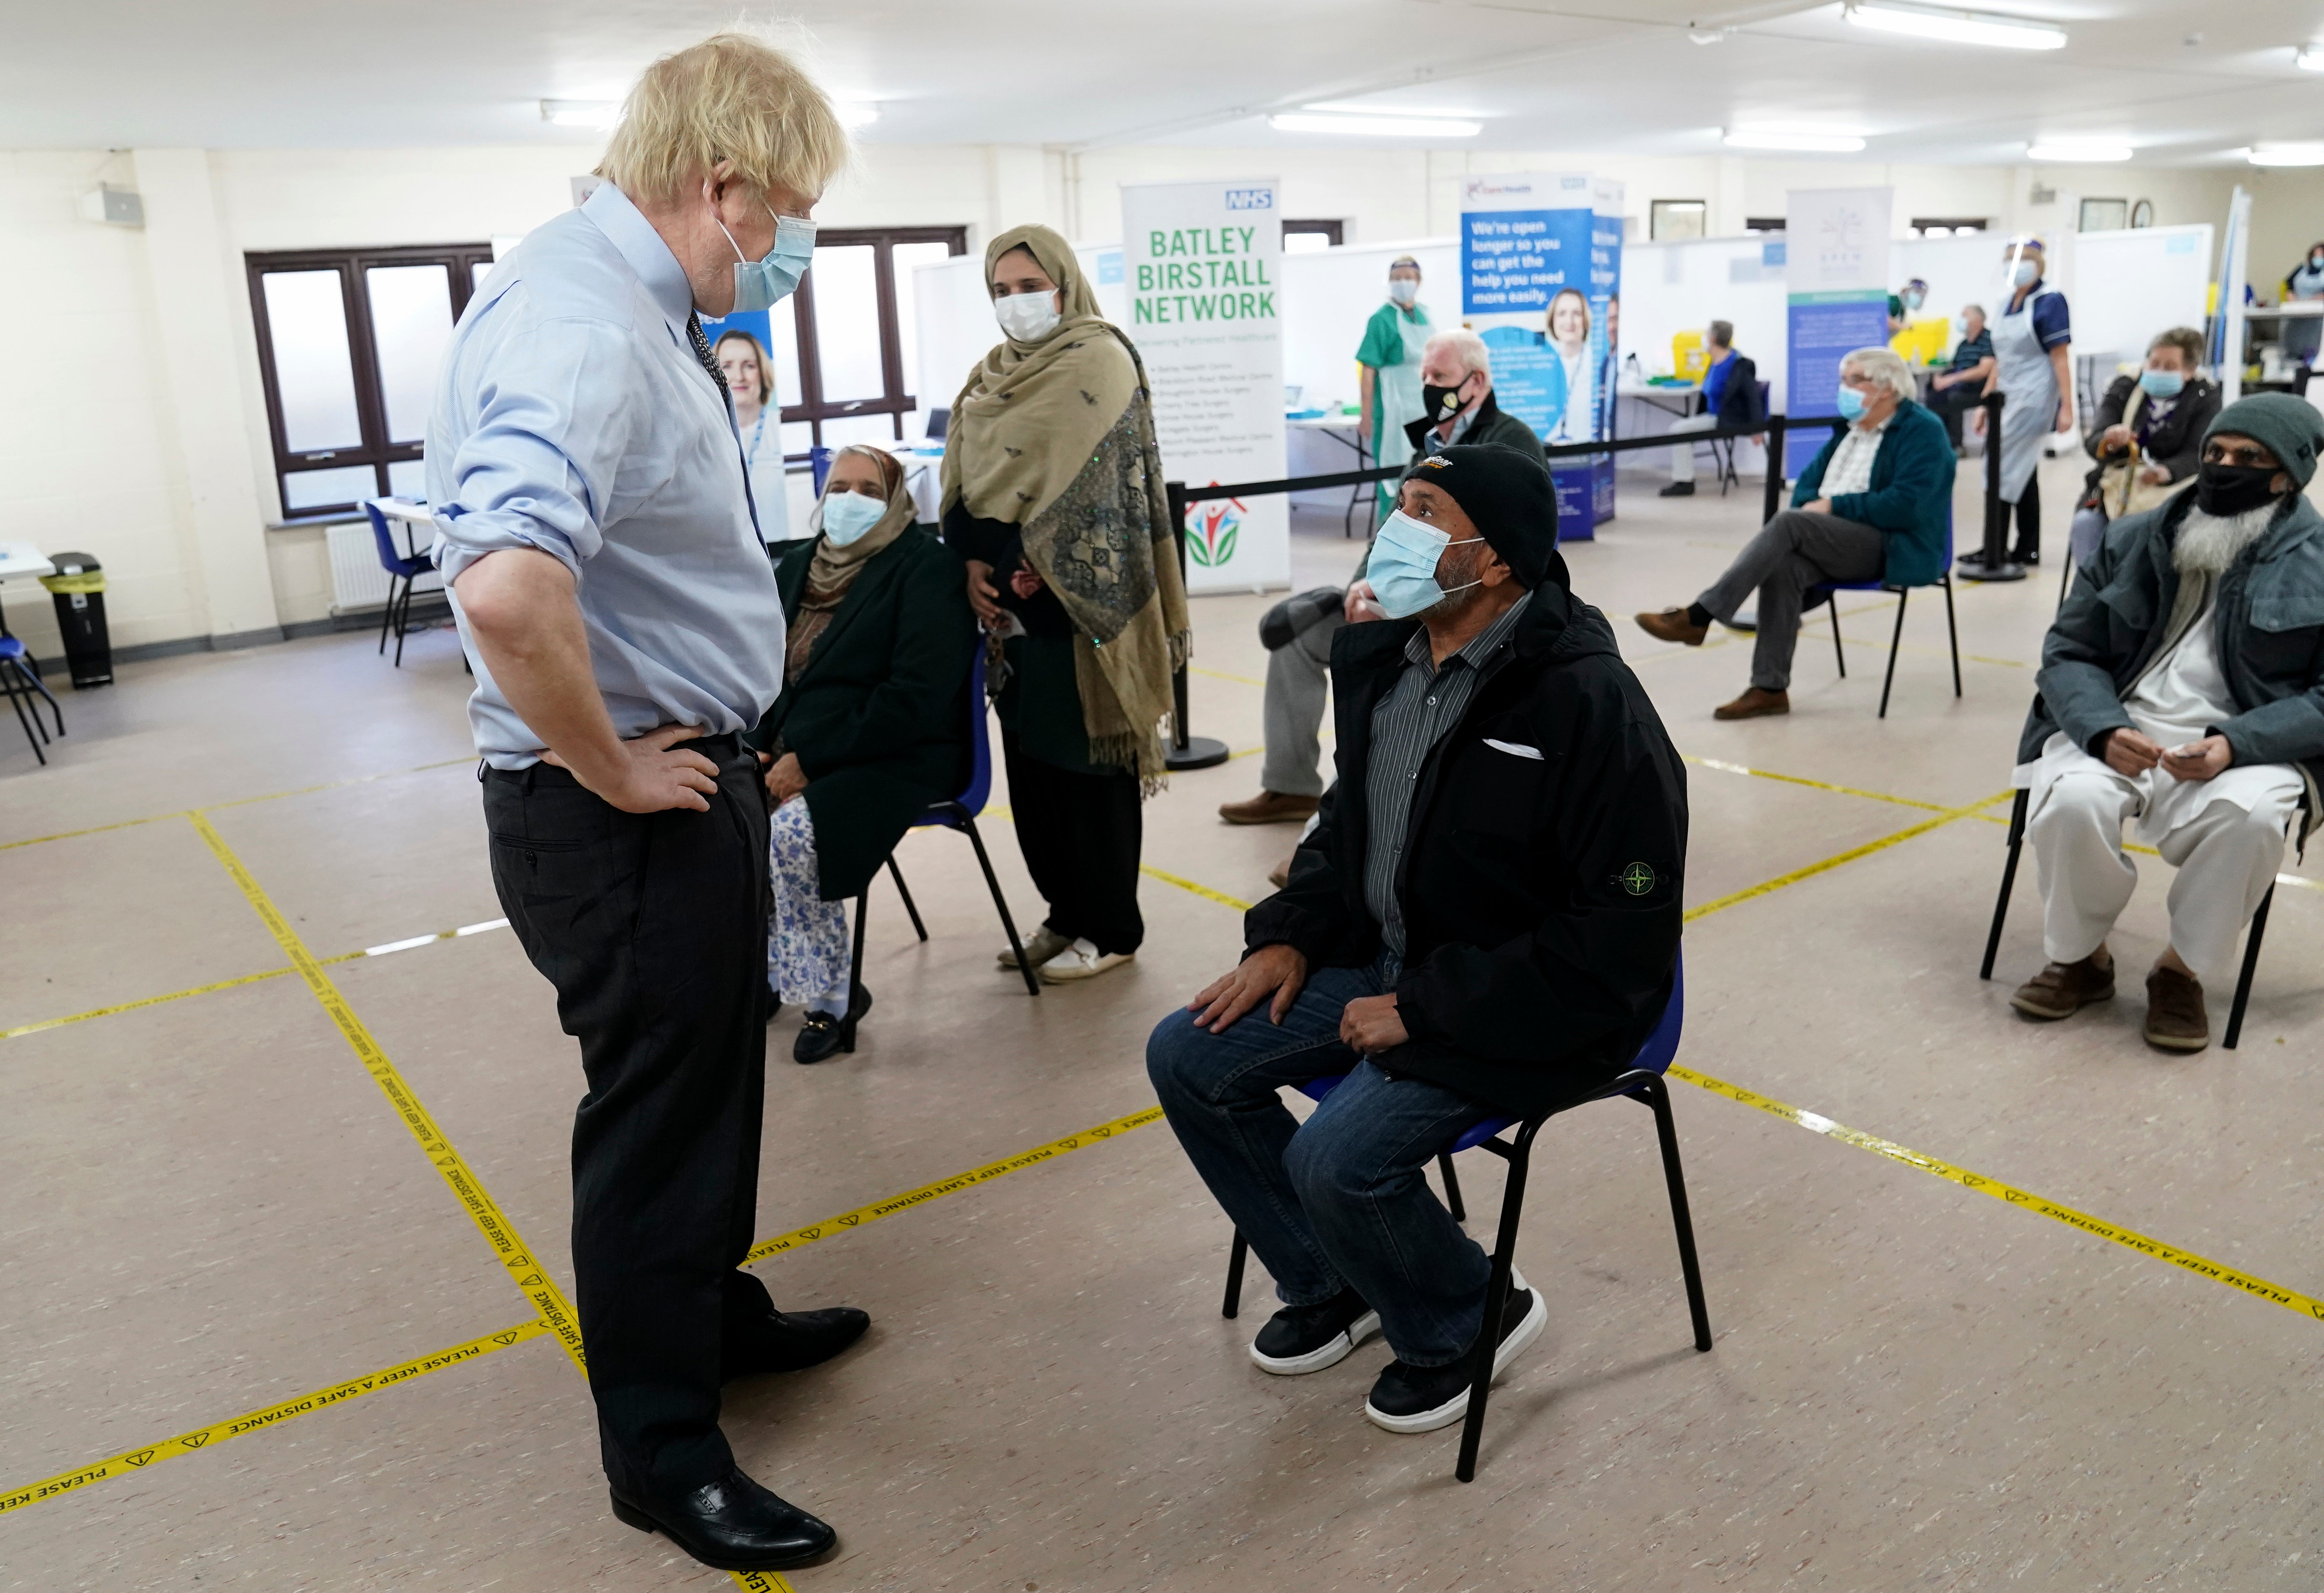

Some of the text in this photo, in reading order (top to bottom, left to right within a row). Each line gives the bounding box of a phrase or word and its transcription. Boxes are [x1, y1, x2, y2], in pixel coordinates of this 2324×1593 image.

[1228, 191, 1271, 208] NHS
[1472, 222, 1546, 236] We're open
[1150, 227, 1255, 257] BATLEY
[1472, 239, 1560, 254] longer so you
[1472, 255, 1544, 272] can get the
[1138, 260, 1271, 291] BIRSTALL
[1473, 270, 1564, 289] help you need
[1473, 289, 1547, 305] more easily.
[1135, 292, 1275, 324] NETWORK
[1009, 1150, 1052, 1167] PLEASE
[981, 1166, 1008, 1178] KEEP
[447, 1169, 473, 1196] DISTANCE
[933, 1179, 965, 1193] SAFE
[465, 1195, 483, 1210] SAFE
[871, 1190, 933, 1215] DISTANCE
[479, 1215, 498, 1230] KEEP
[2038, 1206, 2114, 1237] DISTANCE
[489, 1229, 514, 1253] PLEASE
[2115, 1234, 2157, 1252] SAFE
[2176, 1258, 2220, 1277] KEEP
[2223, 1274, 2290, 1303] PLEASE
[534, 1291, 567, 1326] DISTANCE
[558, 1324, 581, 1345] SAFE
[422, 1346, 479, 1370] PLEASE
[379, 1366, 418, 1384] KEEP
[317, 1386, 358, 1405] SAFE
[229, 1401, 312, 1434] DISTANCE
[37, 1468, 106, 1497] PLEASE
